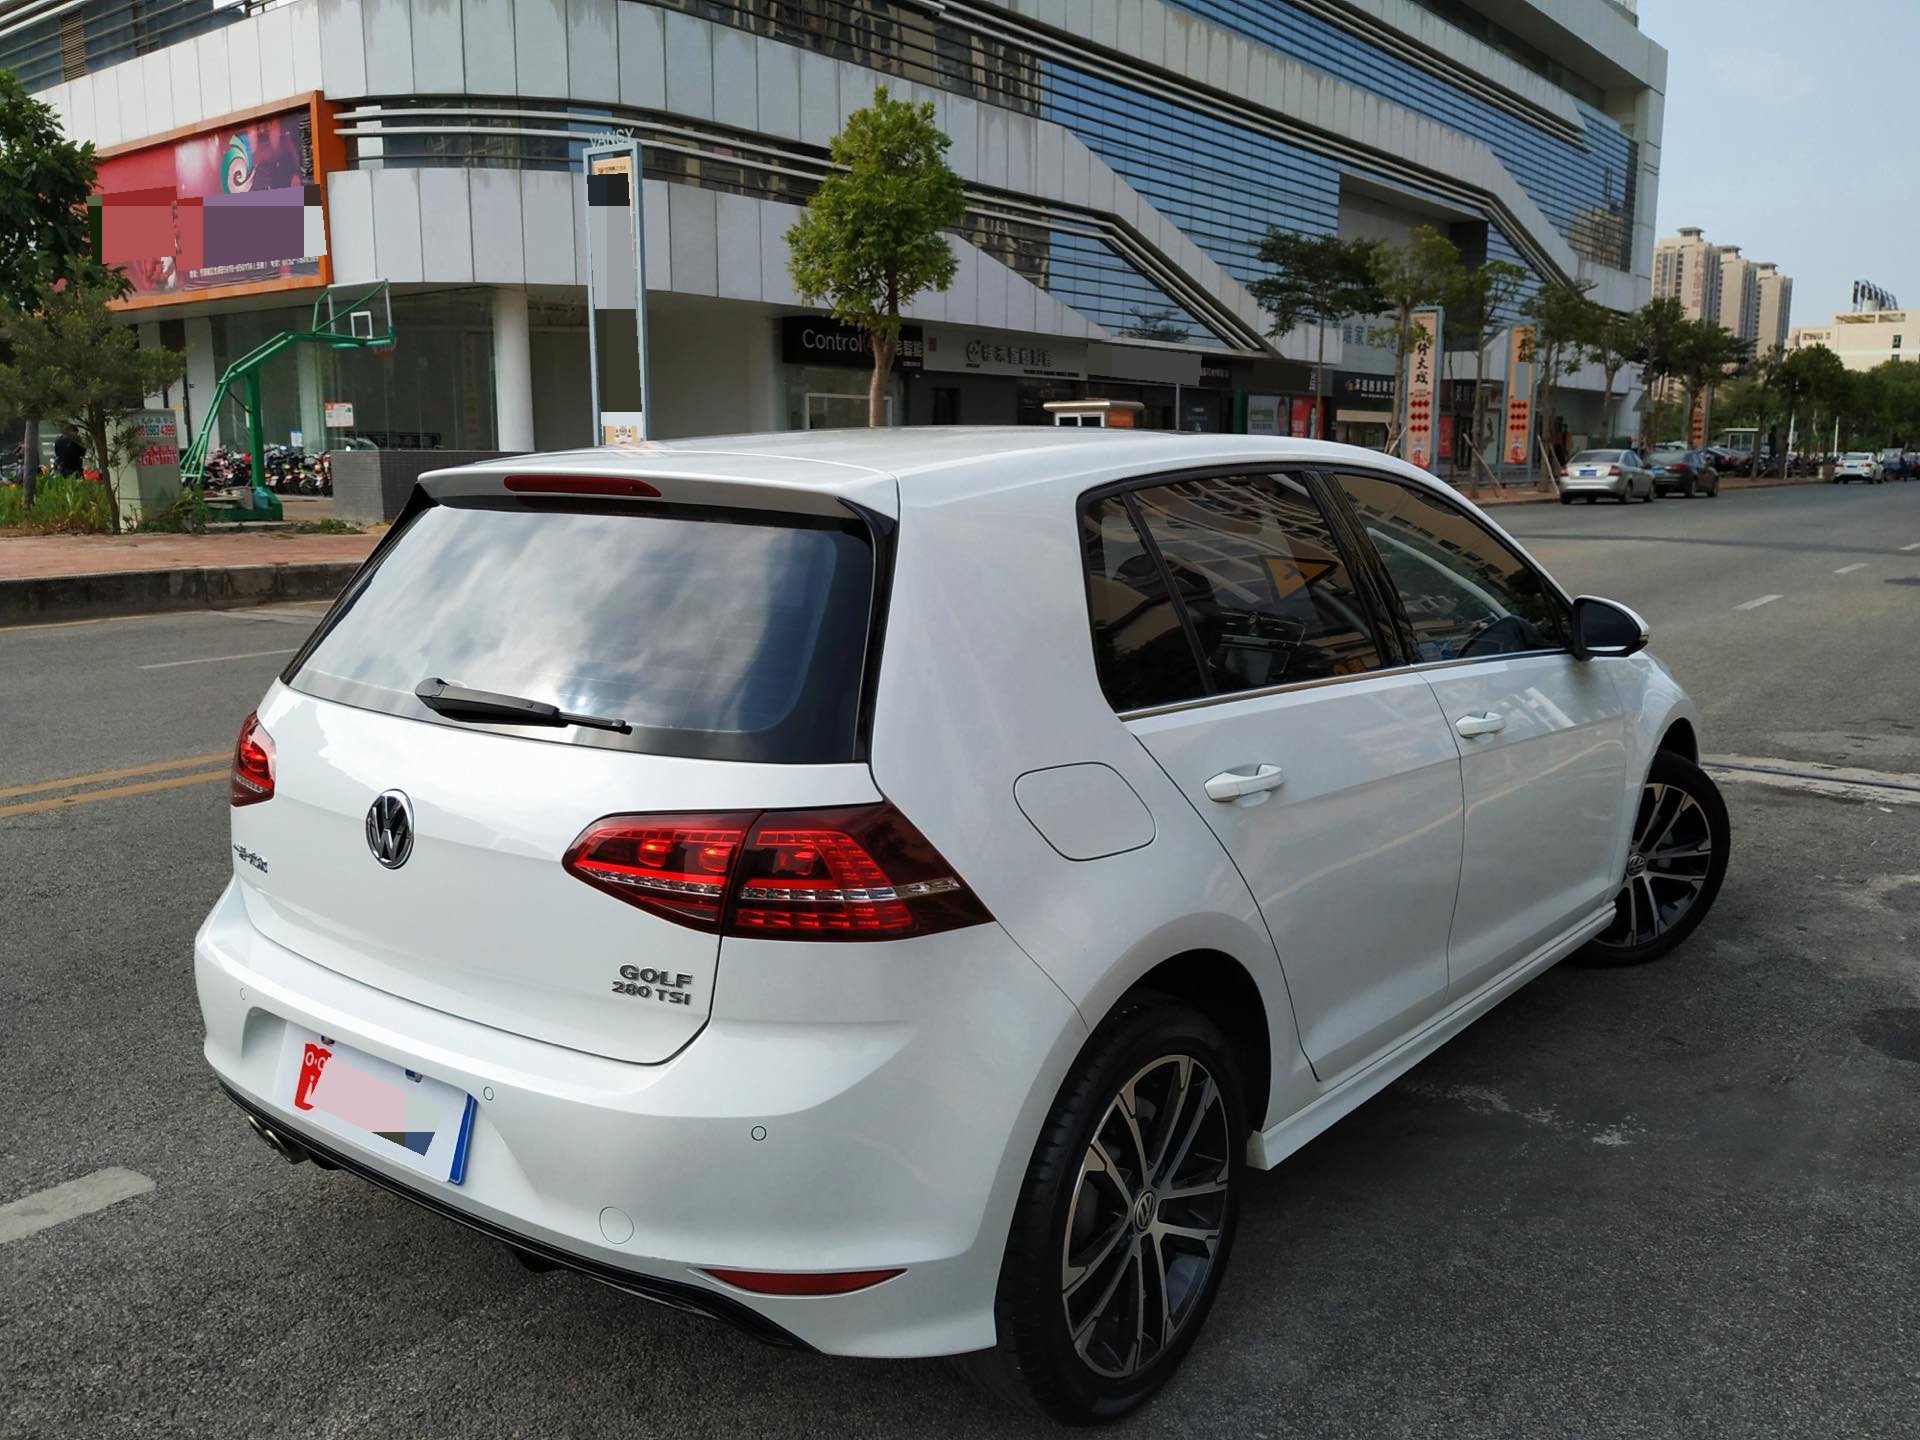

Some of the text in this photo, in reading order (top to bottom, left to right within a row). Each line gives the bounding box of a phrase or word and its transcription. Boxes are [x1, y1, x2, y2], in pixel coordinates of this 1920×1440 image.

[802, 328, 862, 352] Control
[619, 964, 693, 989] GOLF
[611, 980, 691, 1006] 280 TSI
